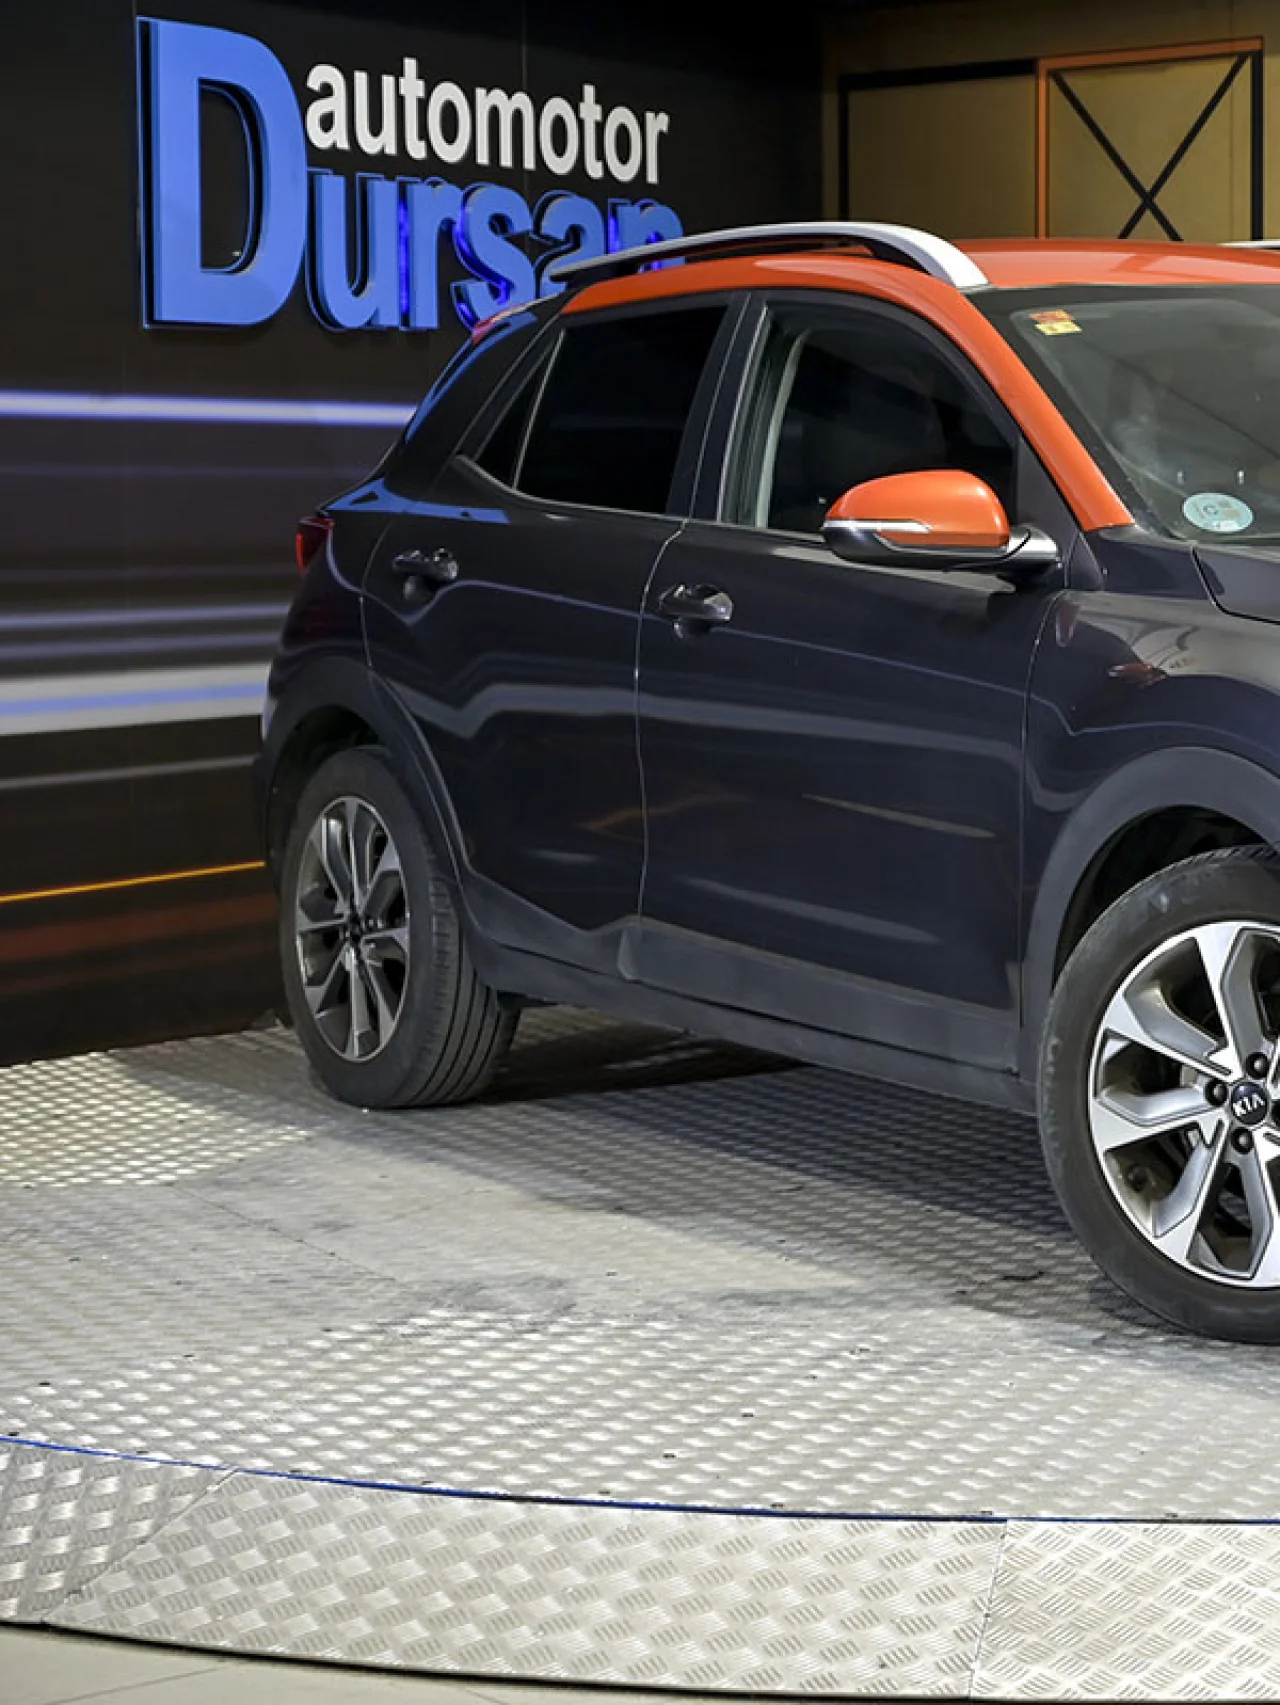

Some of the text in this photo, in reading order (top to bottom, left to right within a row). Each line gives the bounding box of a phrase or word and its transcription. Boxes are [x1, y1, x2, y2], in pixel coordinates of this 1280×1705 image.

[136, 16, 686, 331] Dursan
[305, 57, 670, 184] automotor
[1232, 1094, 1264, 1116] KIA
